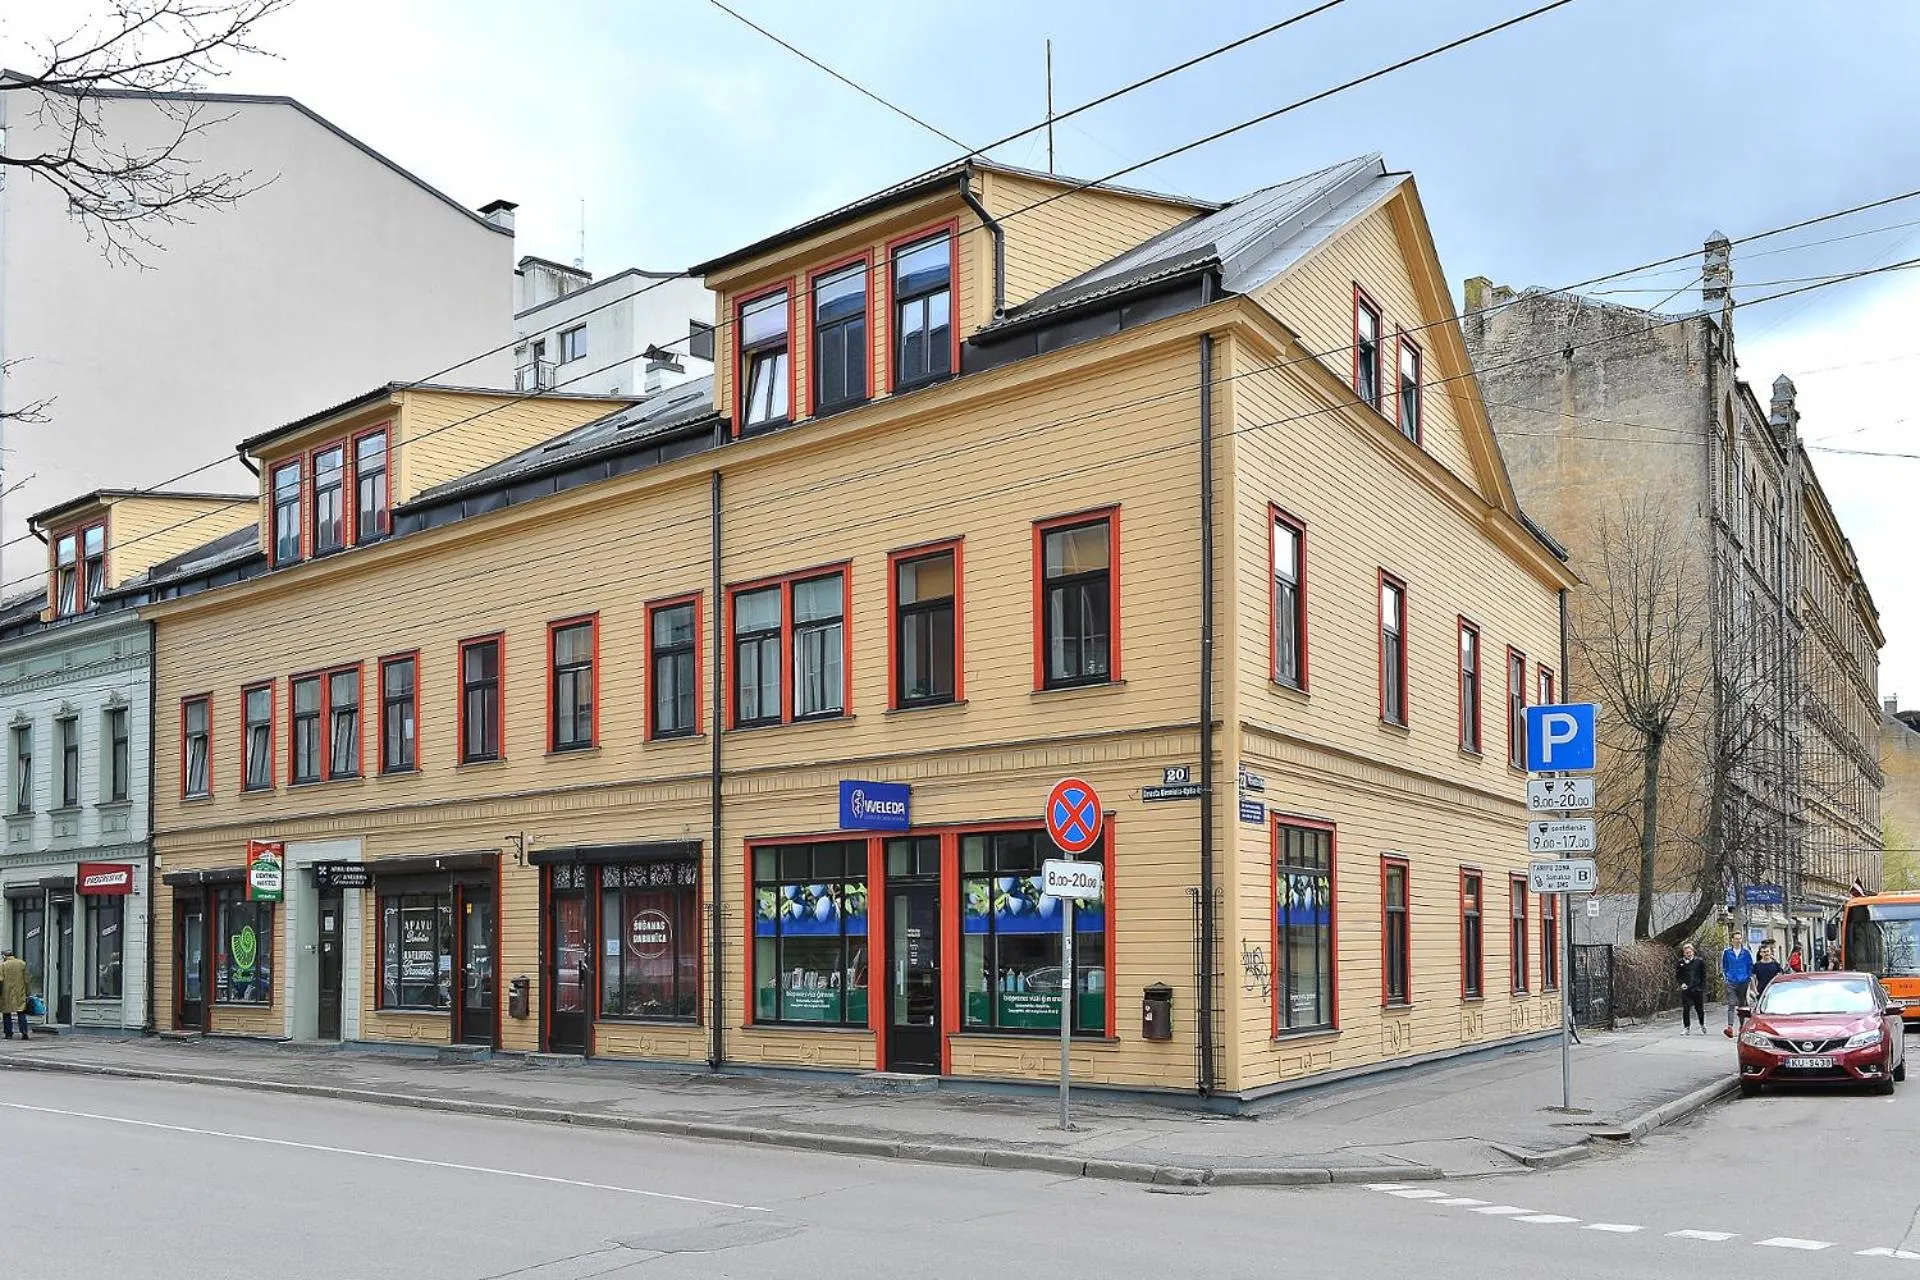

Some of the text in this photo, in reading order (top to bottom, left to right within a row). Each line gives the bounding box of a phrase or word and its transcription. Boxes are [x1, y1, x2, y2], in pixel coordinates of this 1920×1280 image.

[1542, 713, 1578, 763] P
[1167, 769, 1185, 781] 20
[865, 799, 905, 815] WELEDA
[1578, 871, 1588, 881] B
